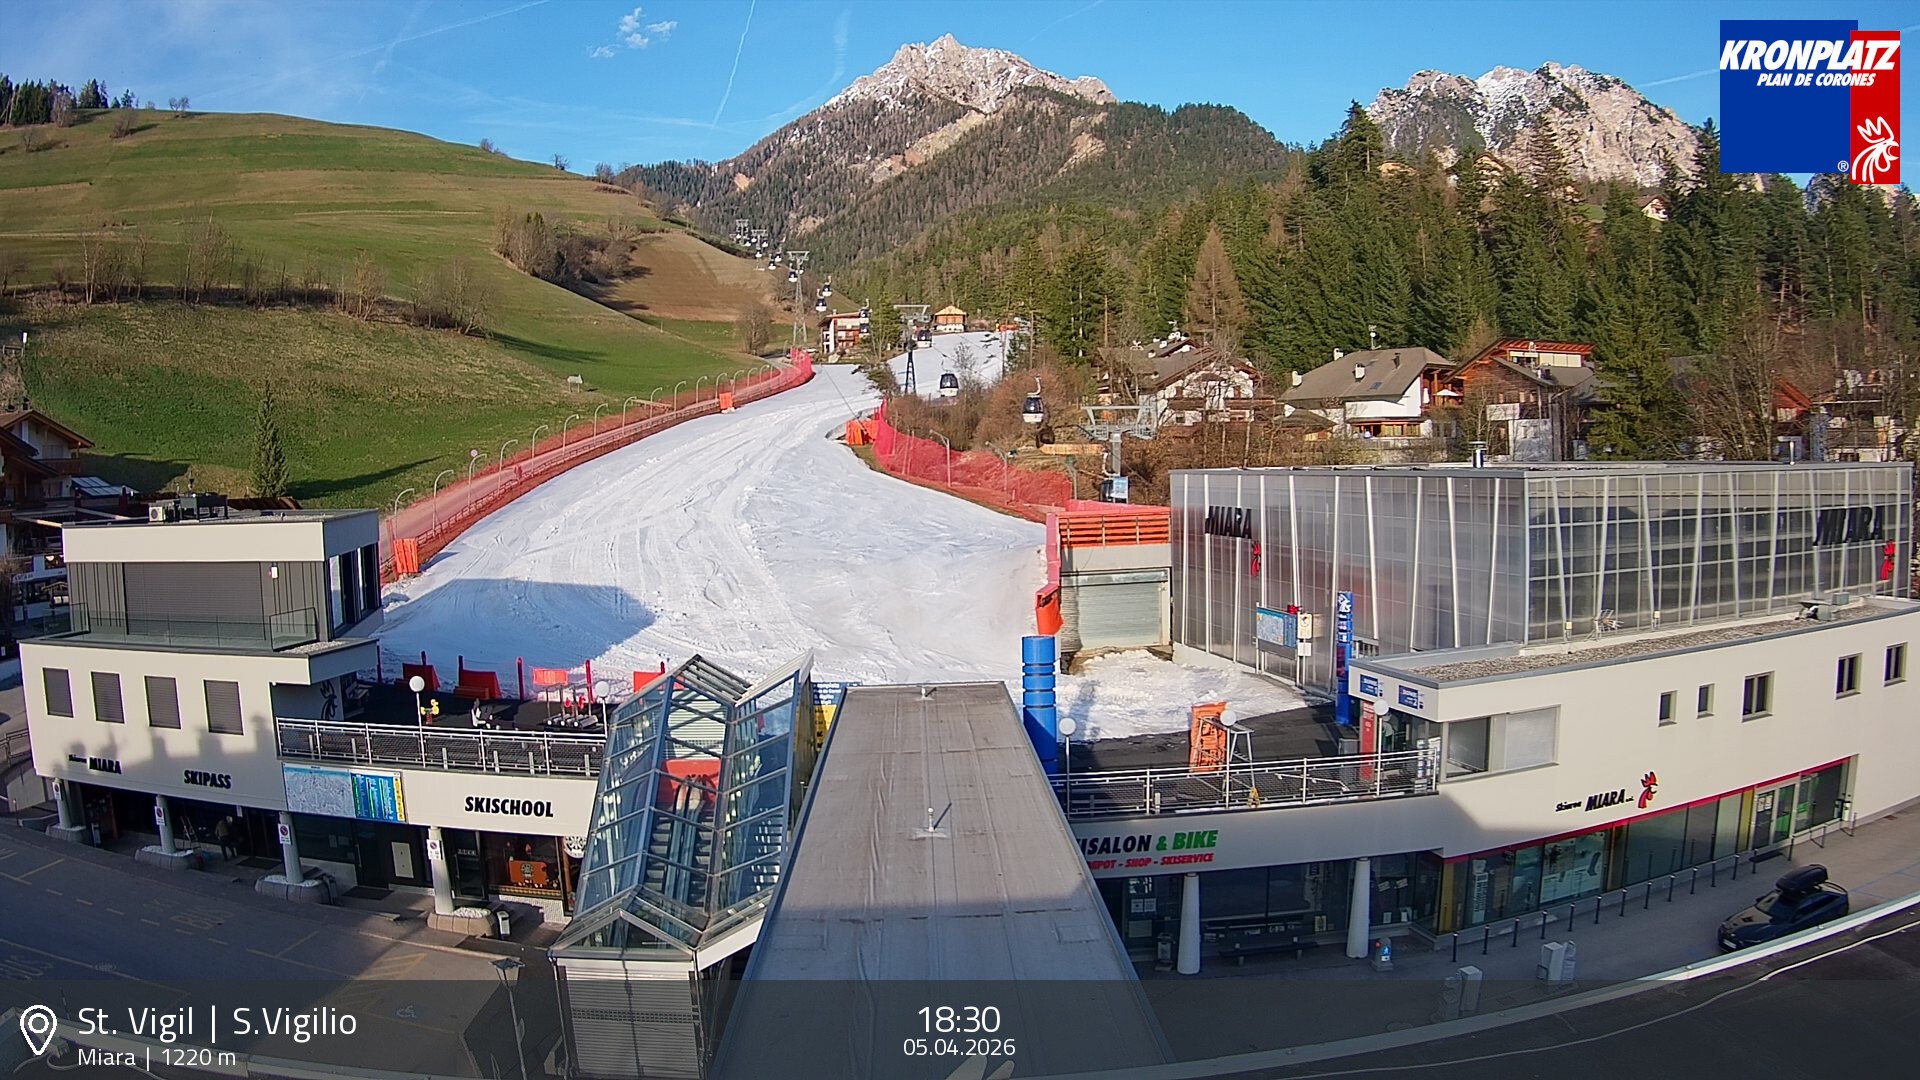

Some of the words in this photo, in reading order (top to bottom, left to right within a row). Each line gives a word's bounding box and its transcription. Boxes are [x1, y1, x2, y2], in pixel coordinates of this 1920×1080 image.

[1205, 505, 1253, 539] MIARA
[1812, 506, 1884, 546] MIARA
[89, 757, 122, 774] MIARA
[184, 770, 232, 789] SKIPASS
[465, 796, 554, 818] SKISCHOOL
[1585, 788, 1625, 811] MIARA
[1156, 835, 1167, 851] &
[1172, 830, 1218, 850] BIKE
[1125, 857, 1152, 868] SHOP
[1160, 853, 1214, 866] SKISERVICE
